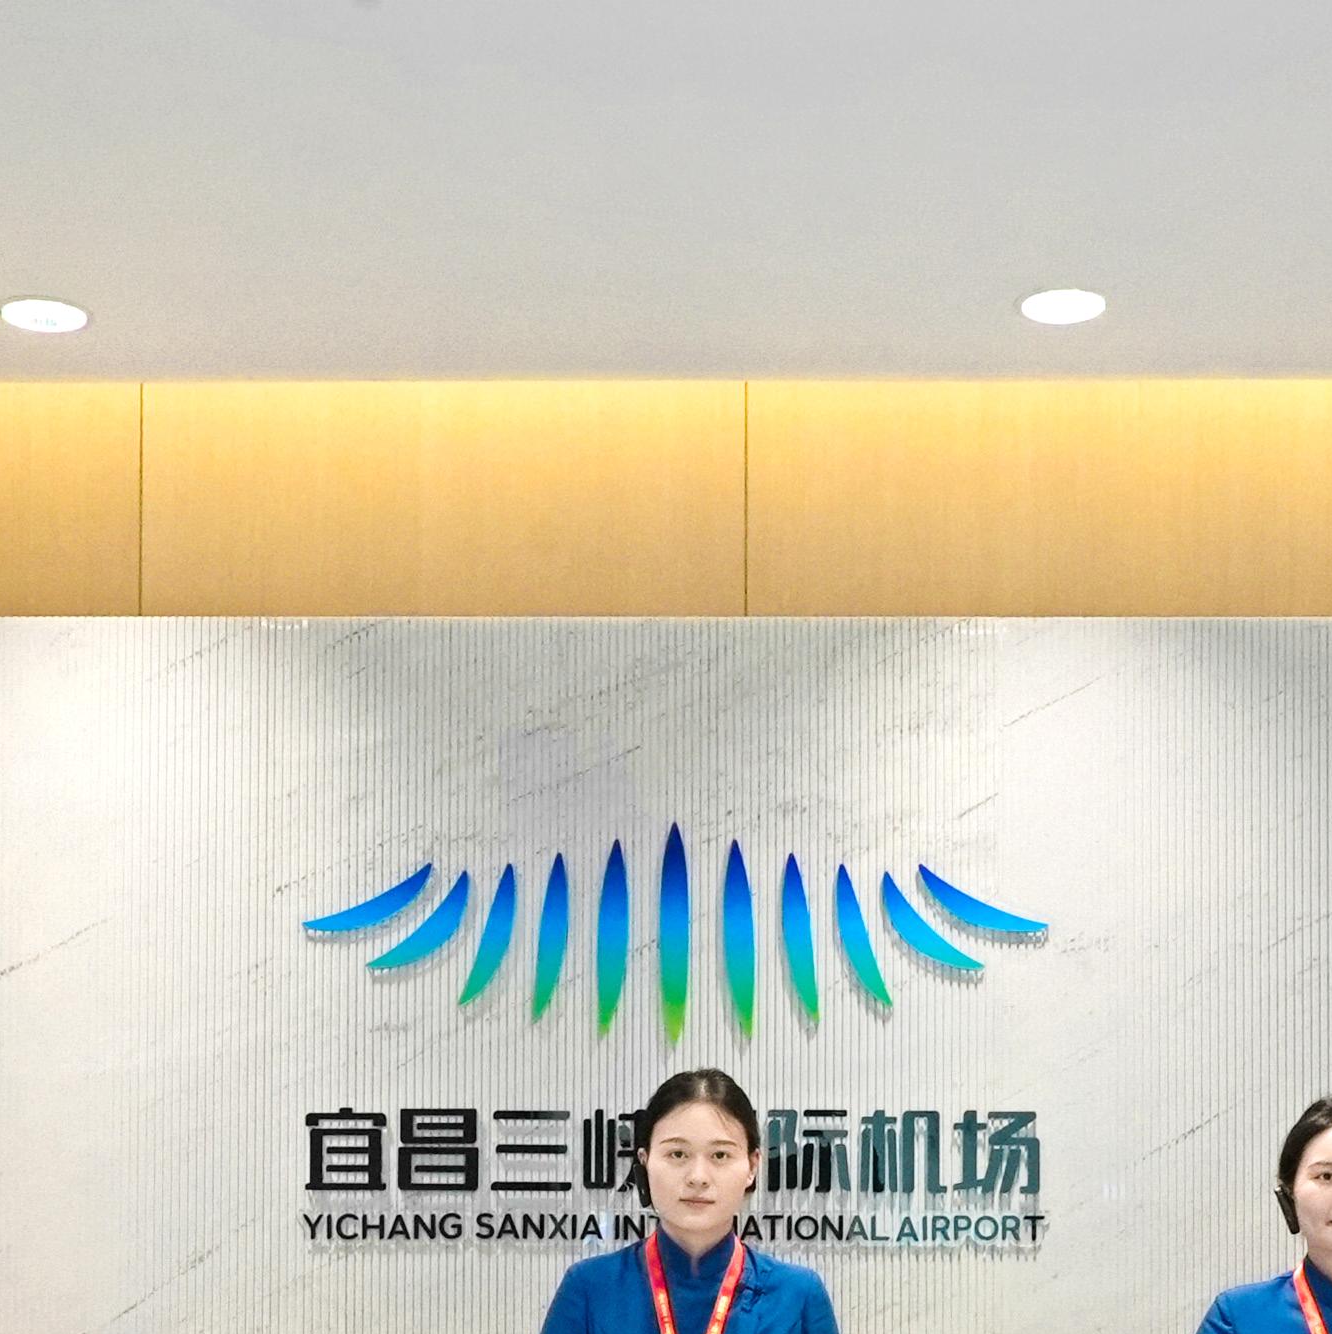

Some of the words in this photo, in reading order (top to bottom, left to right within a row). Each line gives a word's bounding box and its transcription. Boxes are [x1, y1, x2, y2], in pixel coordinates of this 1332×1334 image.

[304, 1106, 1041, 1193] 宜昌三峡际机场
[299, 1211, 463, 1242] YICHANG
[474, 1210, 604, 1242] SANXIA
[614, 1210, 890, 1242] INATIONAL
[896, 1211, 1046, 1243] AIRPORT
